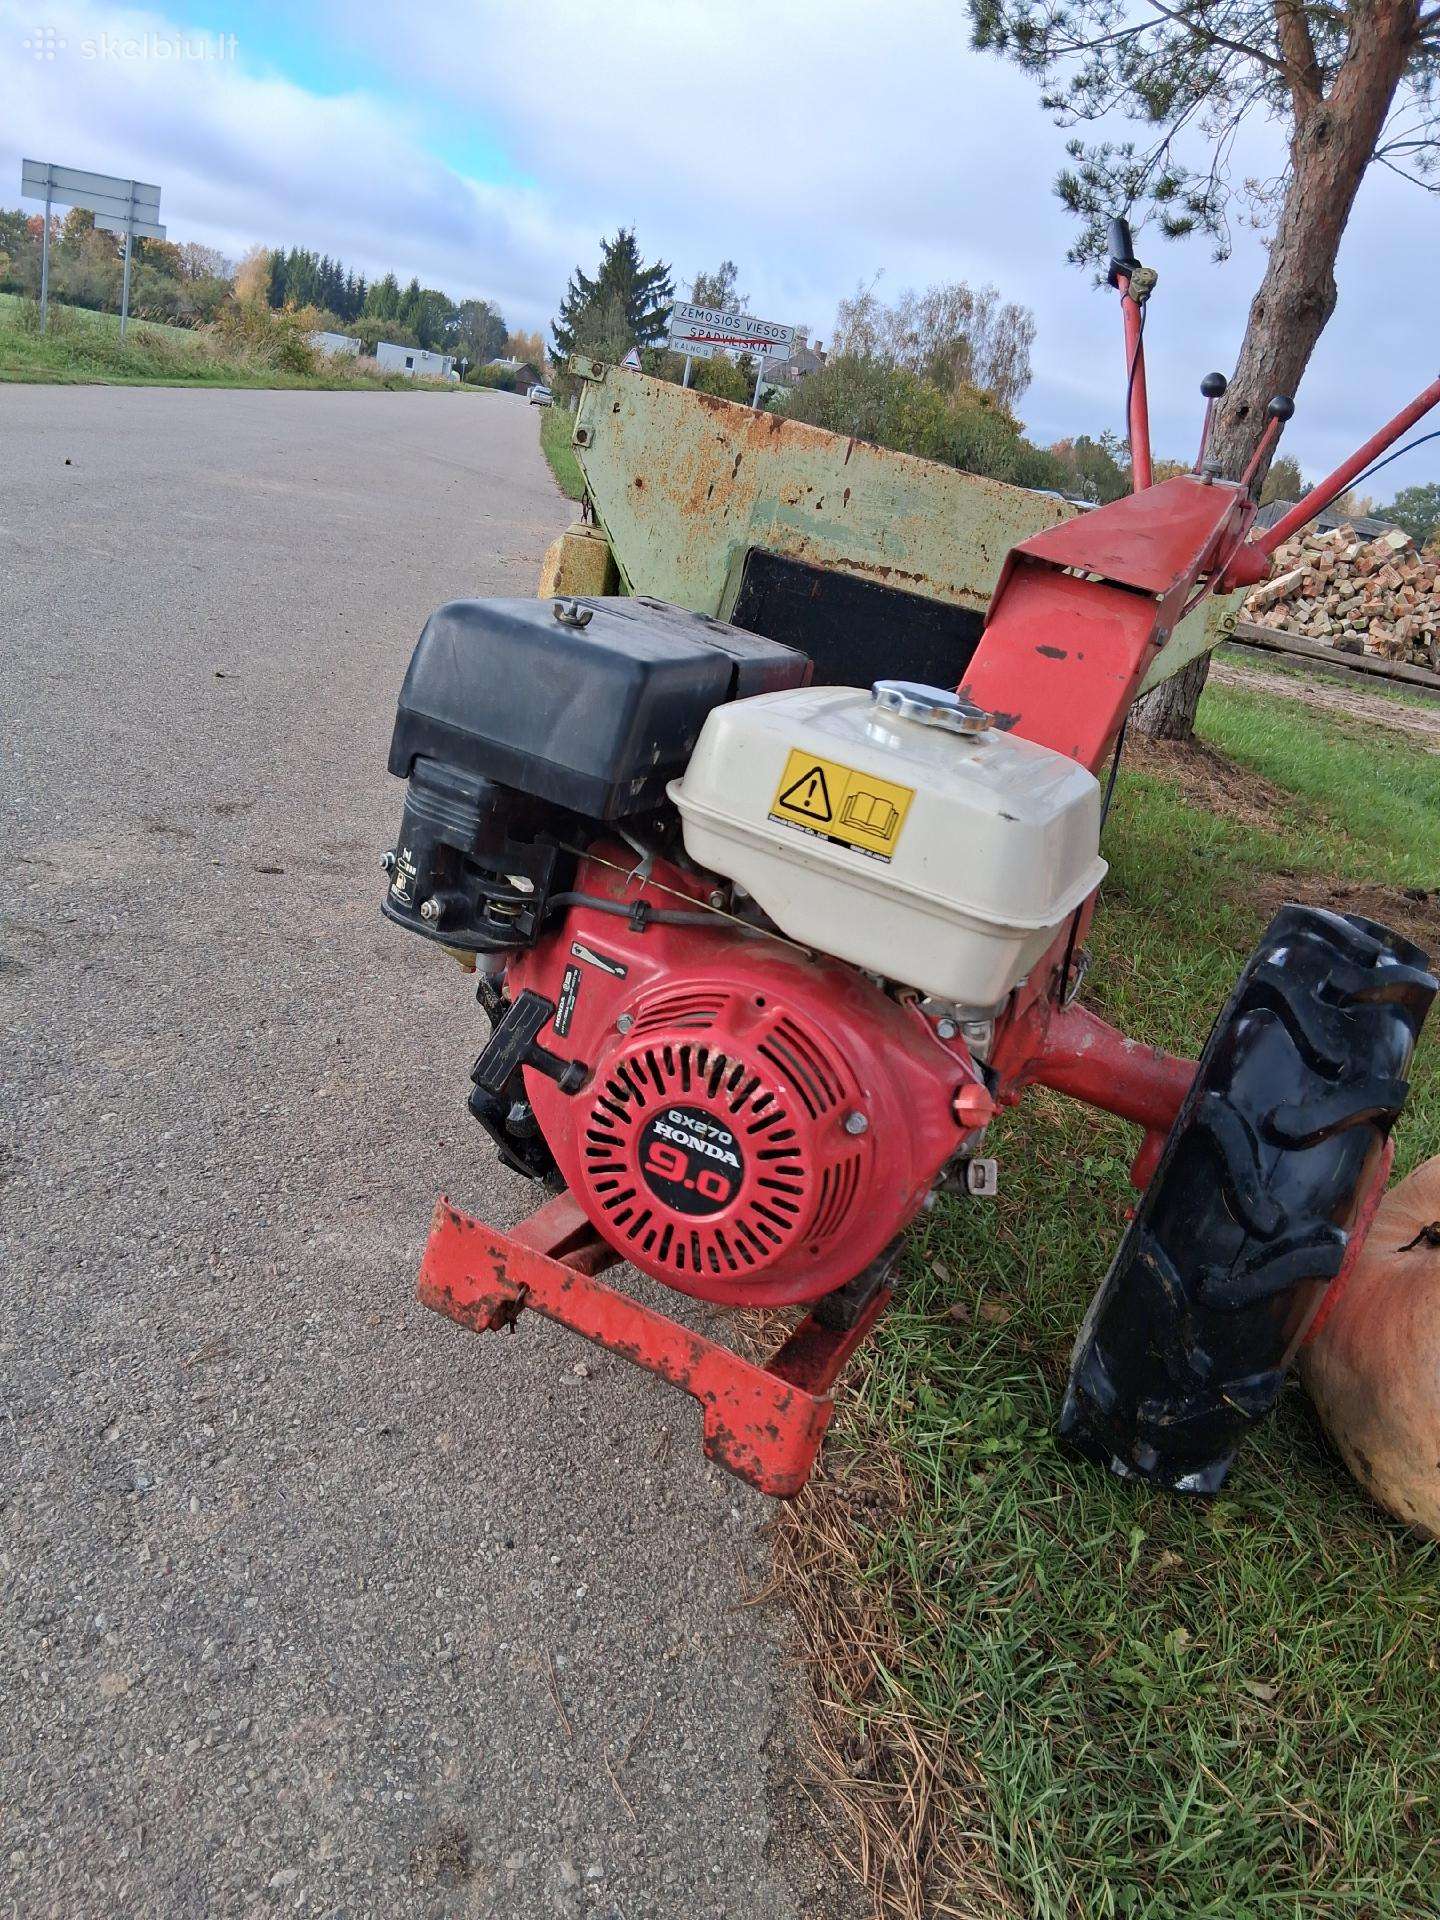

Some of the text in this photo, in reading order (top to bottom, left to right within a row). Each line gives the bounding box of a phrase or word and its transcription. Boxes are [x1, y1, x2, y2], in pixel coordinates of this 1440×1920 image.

[745, 321, 788, 340] VIESOS
[653, 1121, 740, 1168] HONDA
[668, 1110, 732, 1145] GX270
[645, 1141, 730, 1202] 9.0
